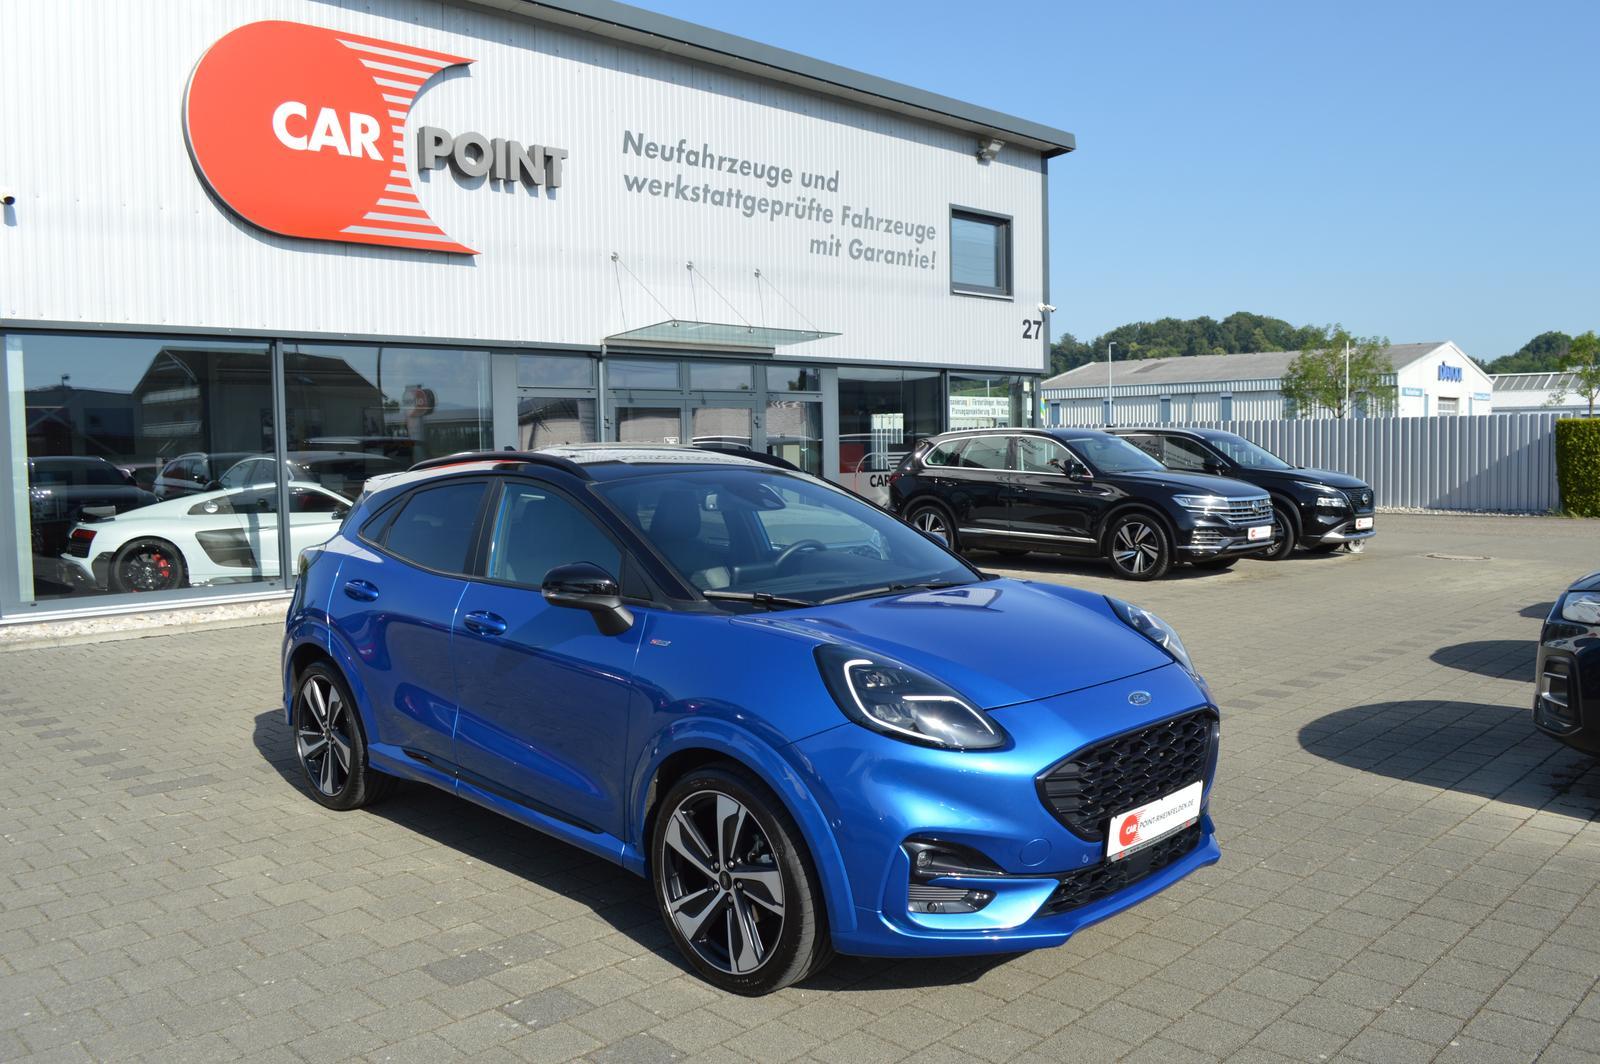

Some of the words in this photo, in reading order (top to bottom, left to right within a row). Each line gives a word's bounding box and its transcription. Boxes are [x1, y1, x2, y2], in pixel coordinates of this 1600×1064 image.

[272, 101, 384, 161] CAR
[417, 125, 568, 189] POINT
[622, 130, 793, 188] Neufahrzeuge
[800, 170, 840, 193] und
[624, 174, 834, 222] werkstattgeprüfte
[841, 205, 937, 245] Fahrzeuge
[809, 234, 842, 257] mit
[848, 238, 937, 270] Garantie!
[1022, 319, 1042, 340] 27
